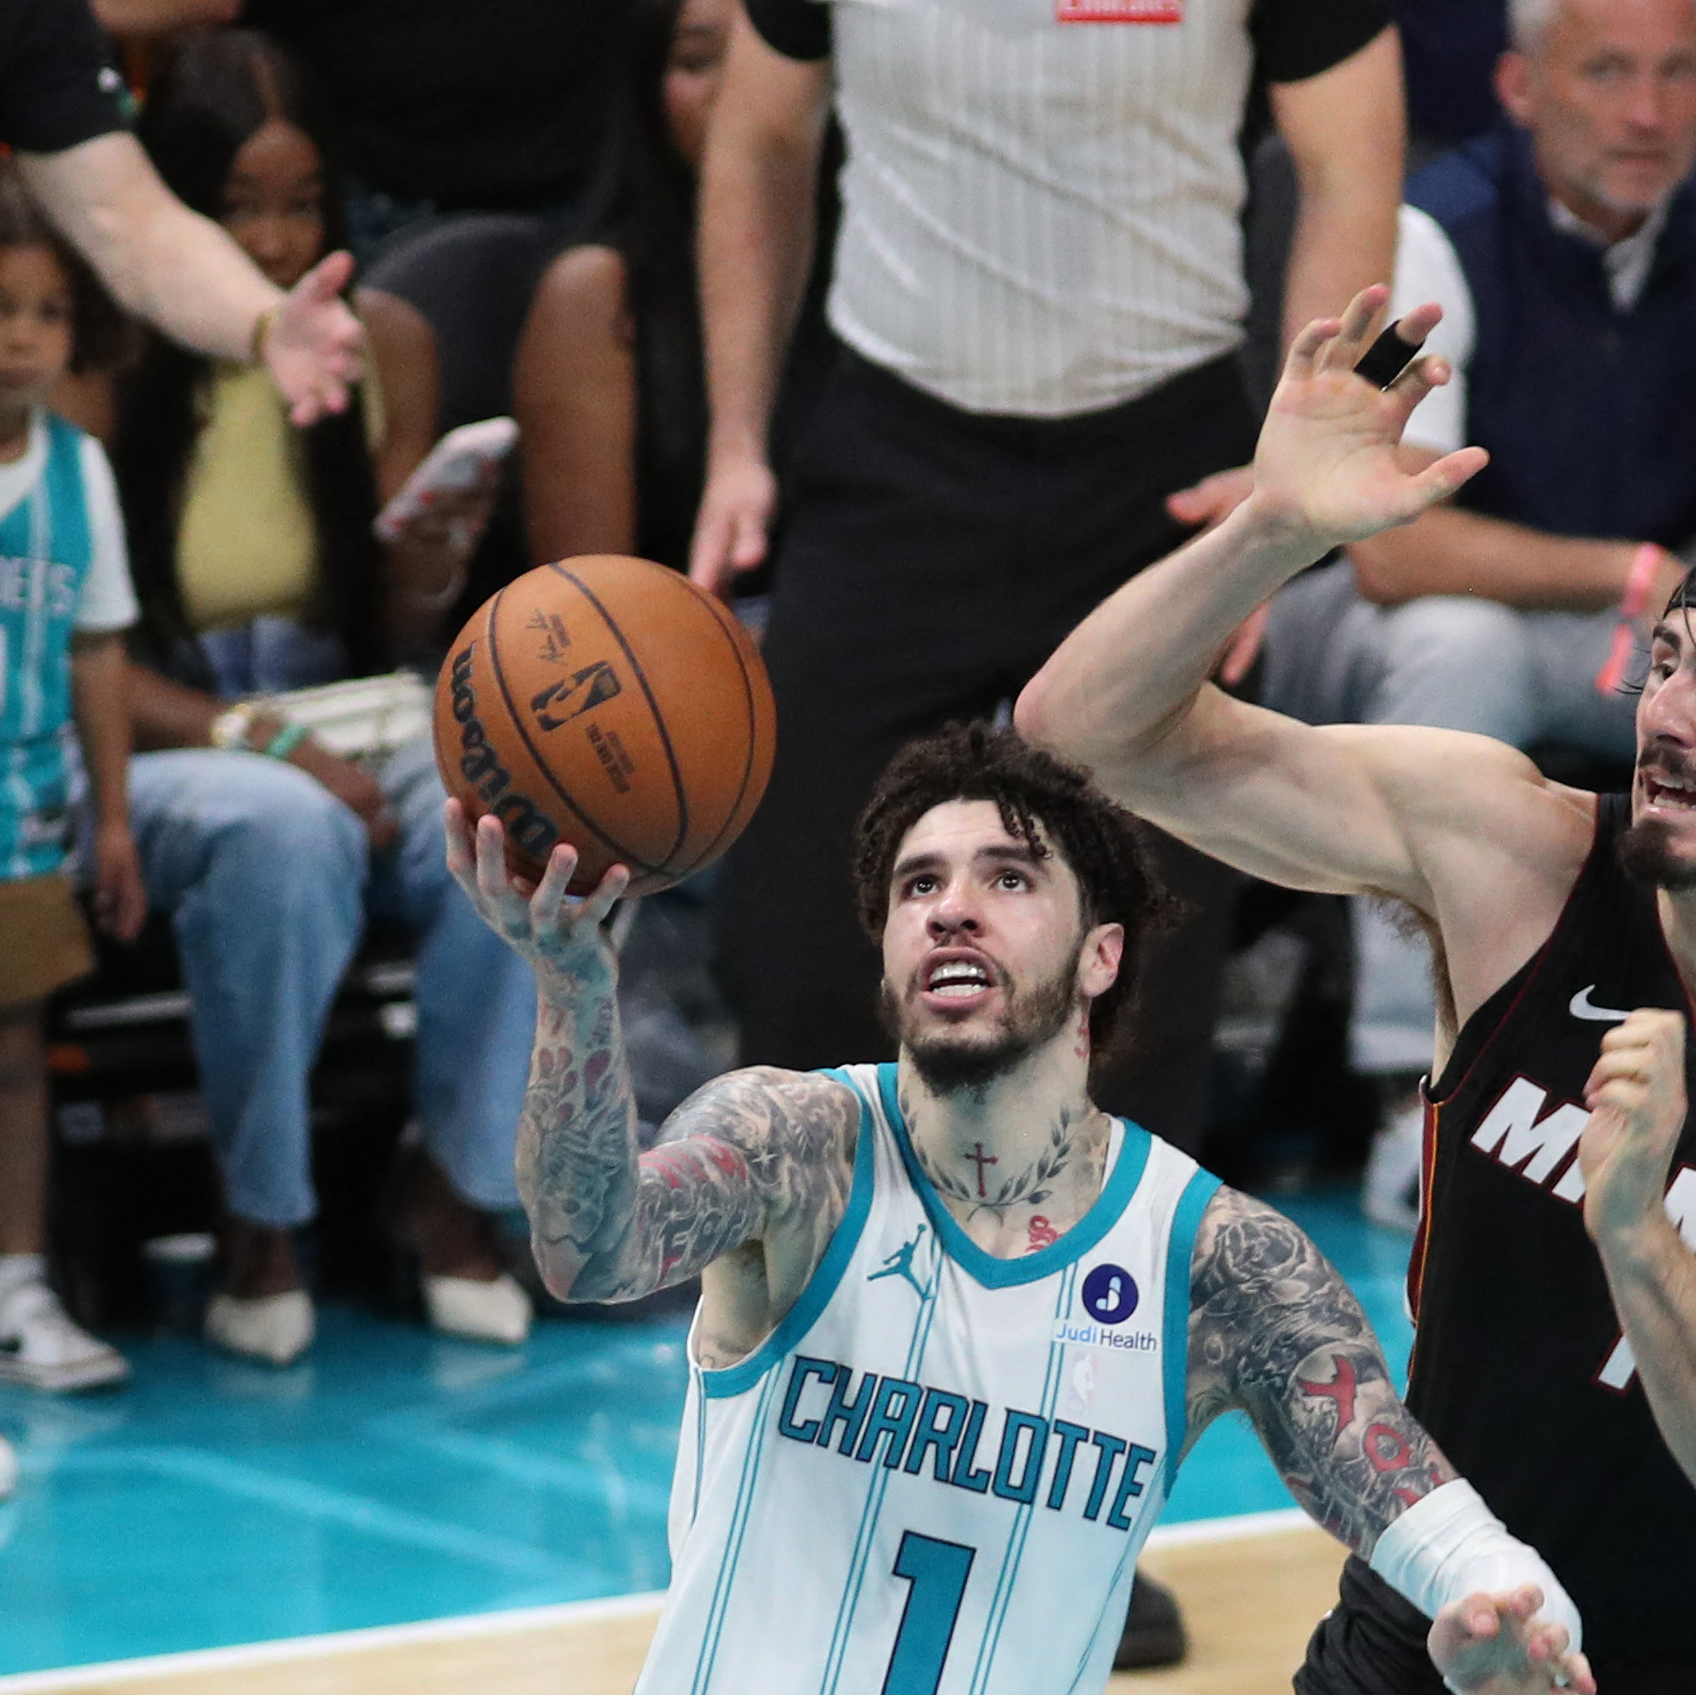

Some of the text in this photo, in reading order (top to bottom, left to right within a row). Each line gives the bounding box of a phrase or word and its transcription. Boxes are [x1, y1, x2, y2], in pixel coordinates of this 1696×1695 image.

[451, 639, 559, 857] Wilson
[1056, 1323, 1157, 1352] Judi Health
[778, 1354, 1157, 1532] CHARLOTTE
